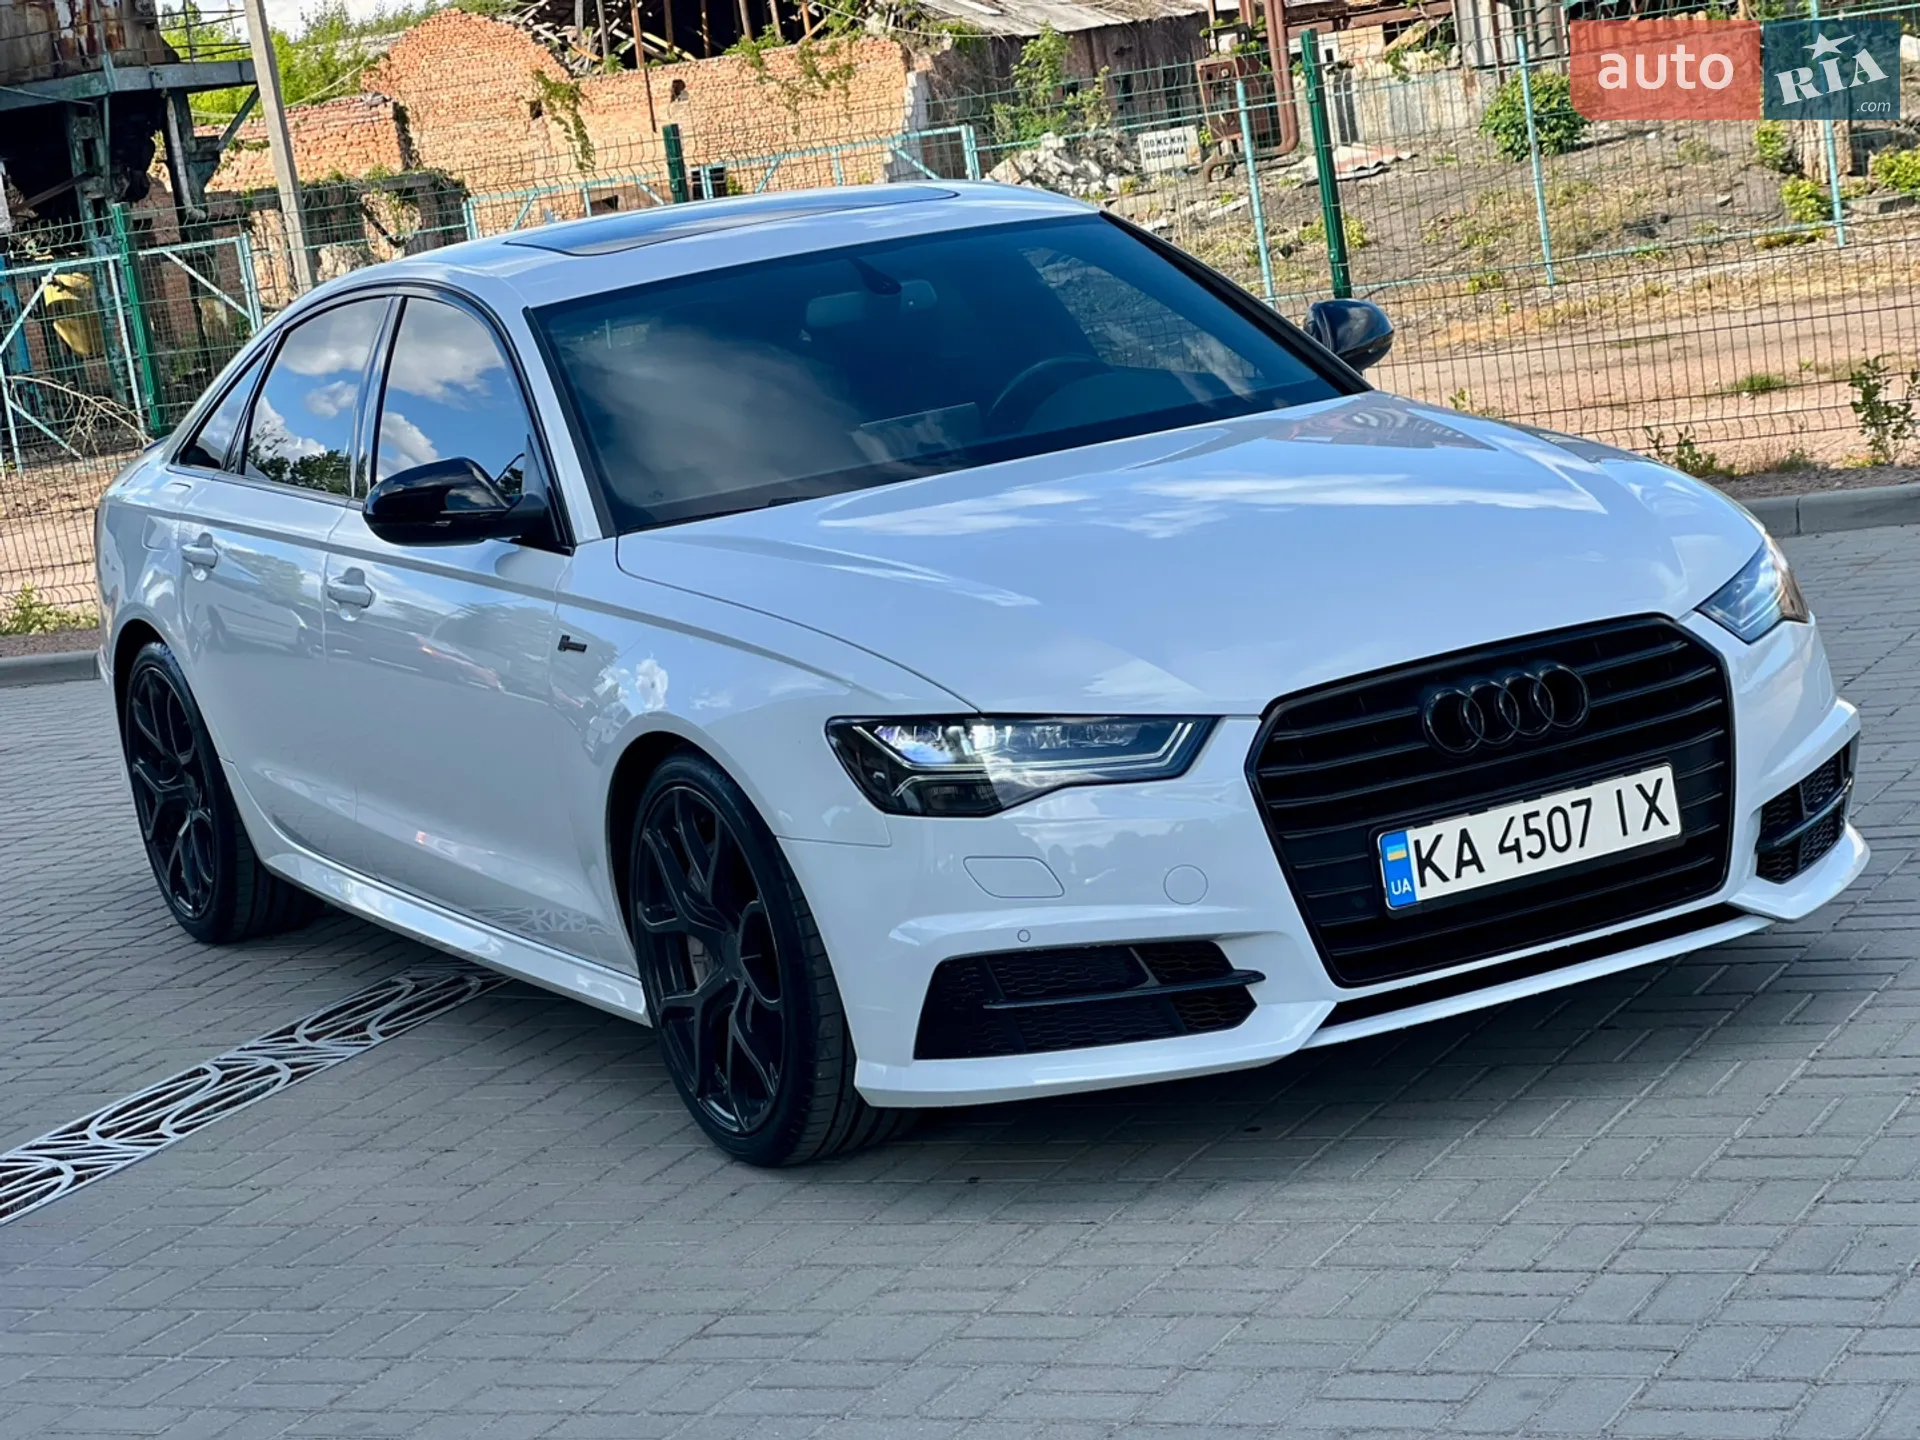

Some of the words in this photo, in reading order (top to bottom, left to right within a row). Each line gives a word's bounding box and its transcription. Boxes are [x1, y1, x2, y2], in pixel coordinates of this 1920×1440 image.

[1413, 828, 1485, 888] KA
[1498, 797, 1592, 864] 4507
[1615, 778, 1671, 837] IX
[1391, 879, 1412, 896] UA
